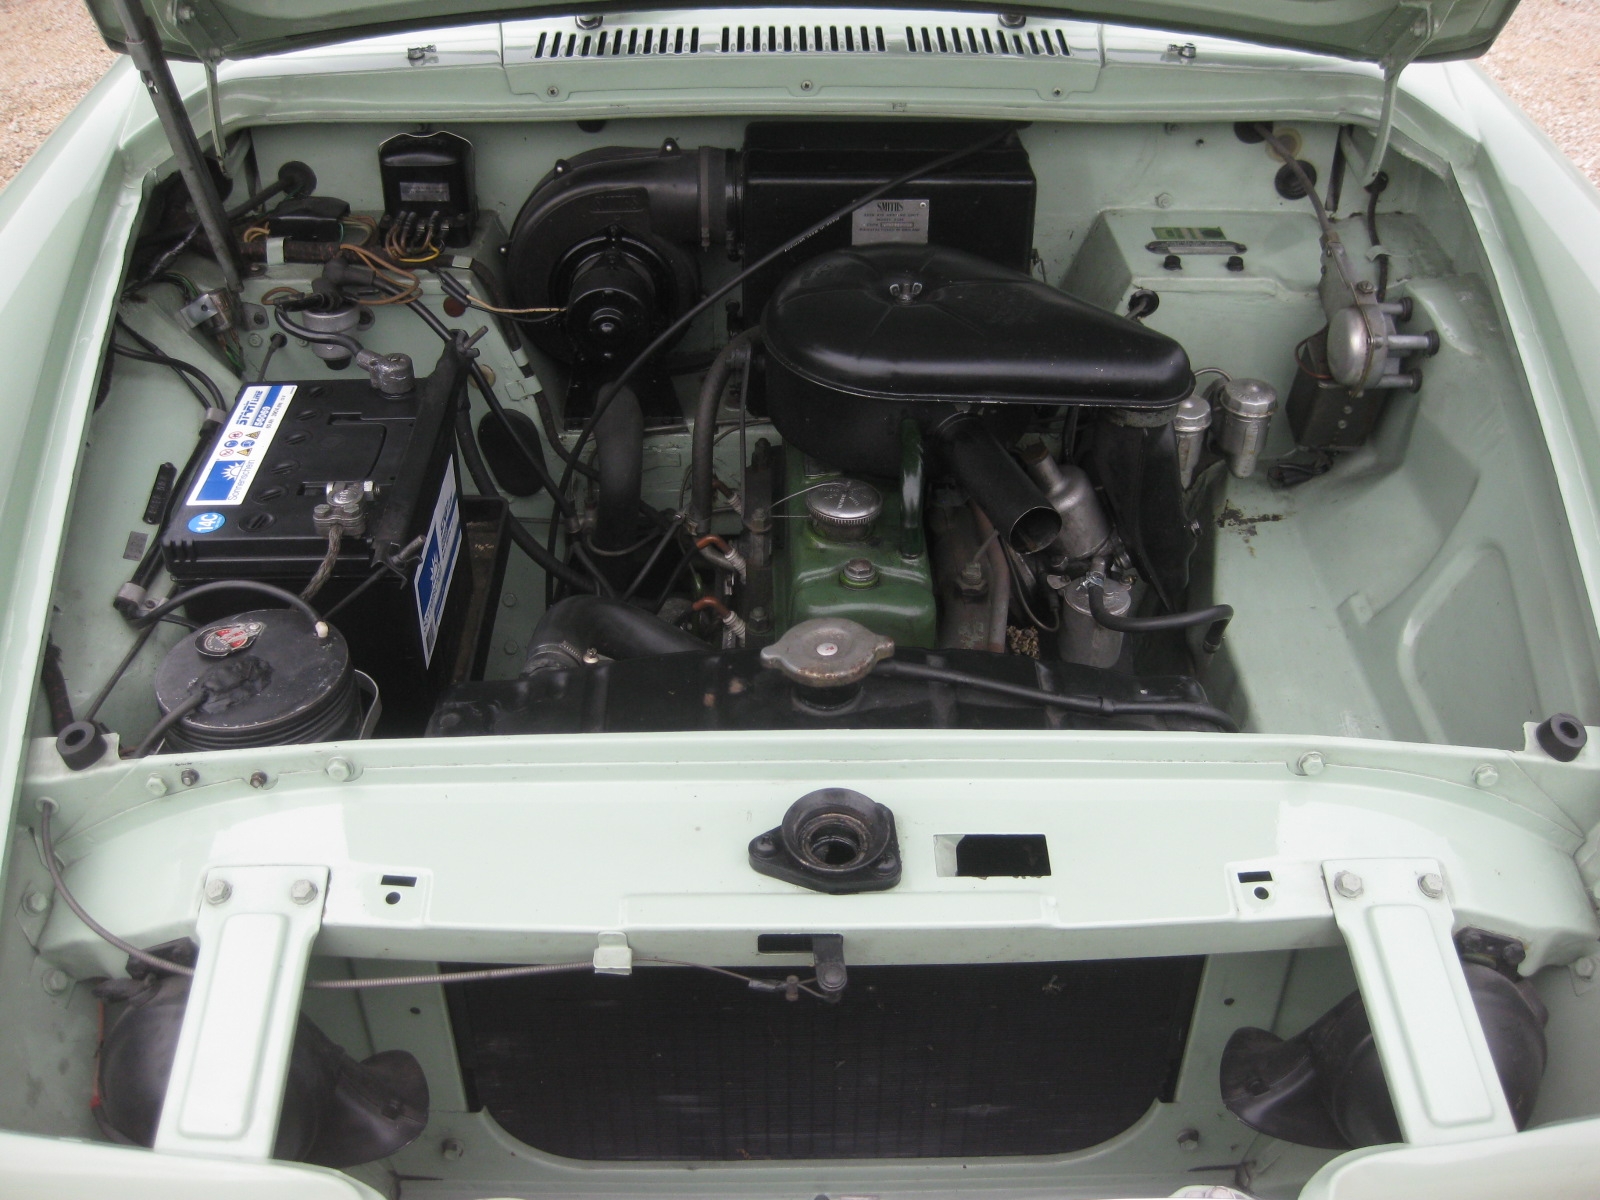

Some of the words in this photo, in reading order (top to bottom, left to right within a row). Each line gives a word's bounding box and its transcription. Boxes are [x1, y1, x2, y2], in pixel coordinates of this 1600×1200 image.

[877, 202, 903, 211] SMITHS
[227, 459, 255, 500] Sonnenschein
[196, 514, 219, 532] 14C
